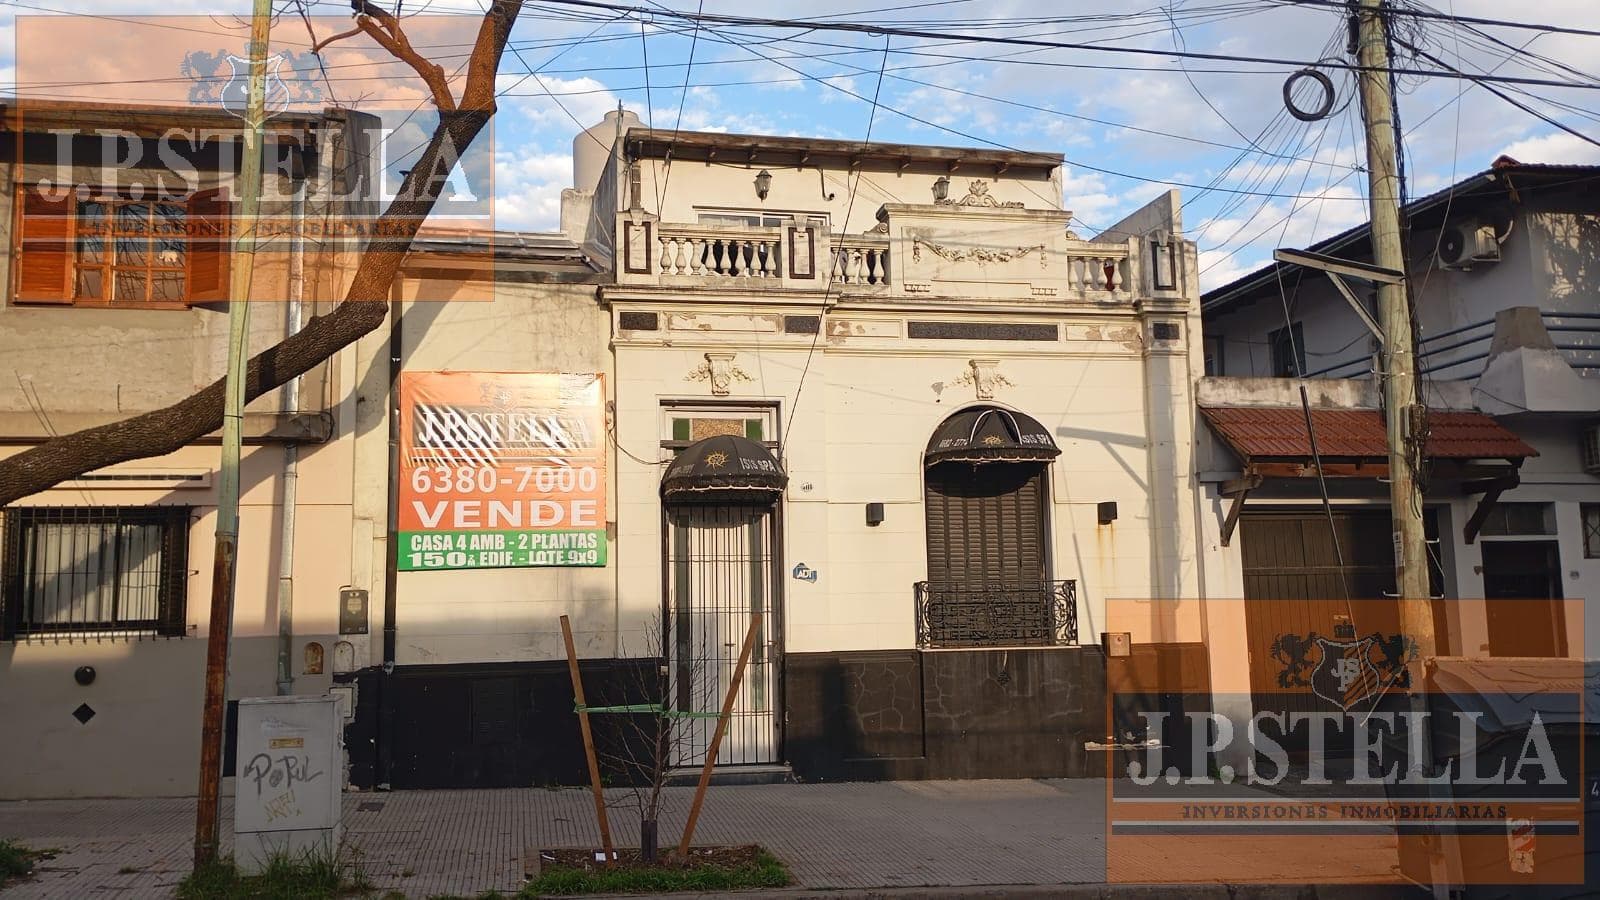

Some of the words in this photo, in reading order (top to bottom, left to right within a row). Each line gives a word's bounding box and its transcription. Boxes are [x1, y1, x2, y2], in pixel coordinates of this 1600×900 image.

[758, 460, 777, 473] SPA
[412, 466, 597, 494] 6380-7000
[412, 500, 597, 528] VENDE
[411, 535, 454, 551] CASA
[456, 534, 467, 550] 4
[469, 534, 505, 550] AMB
[518, 534, 528, 549] 2
[531, 533, 598, 549] PLANTAS
[479, 551, 515, 566] EDIF.
[528, 551, 565, 565] LOTE
